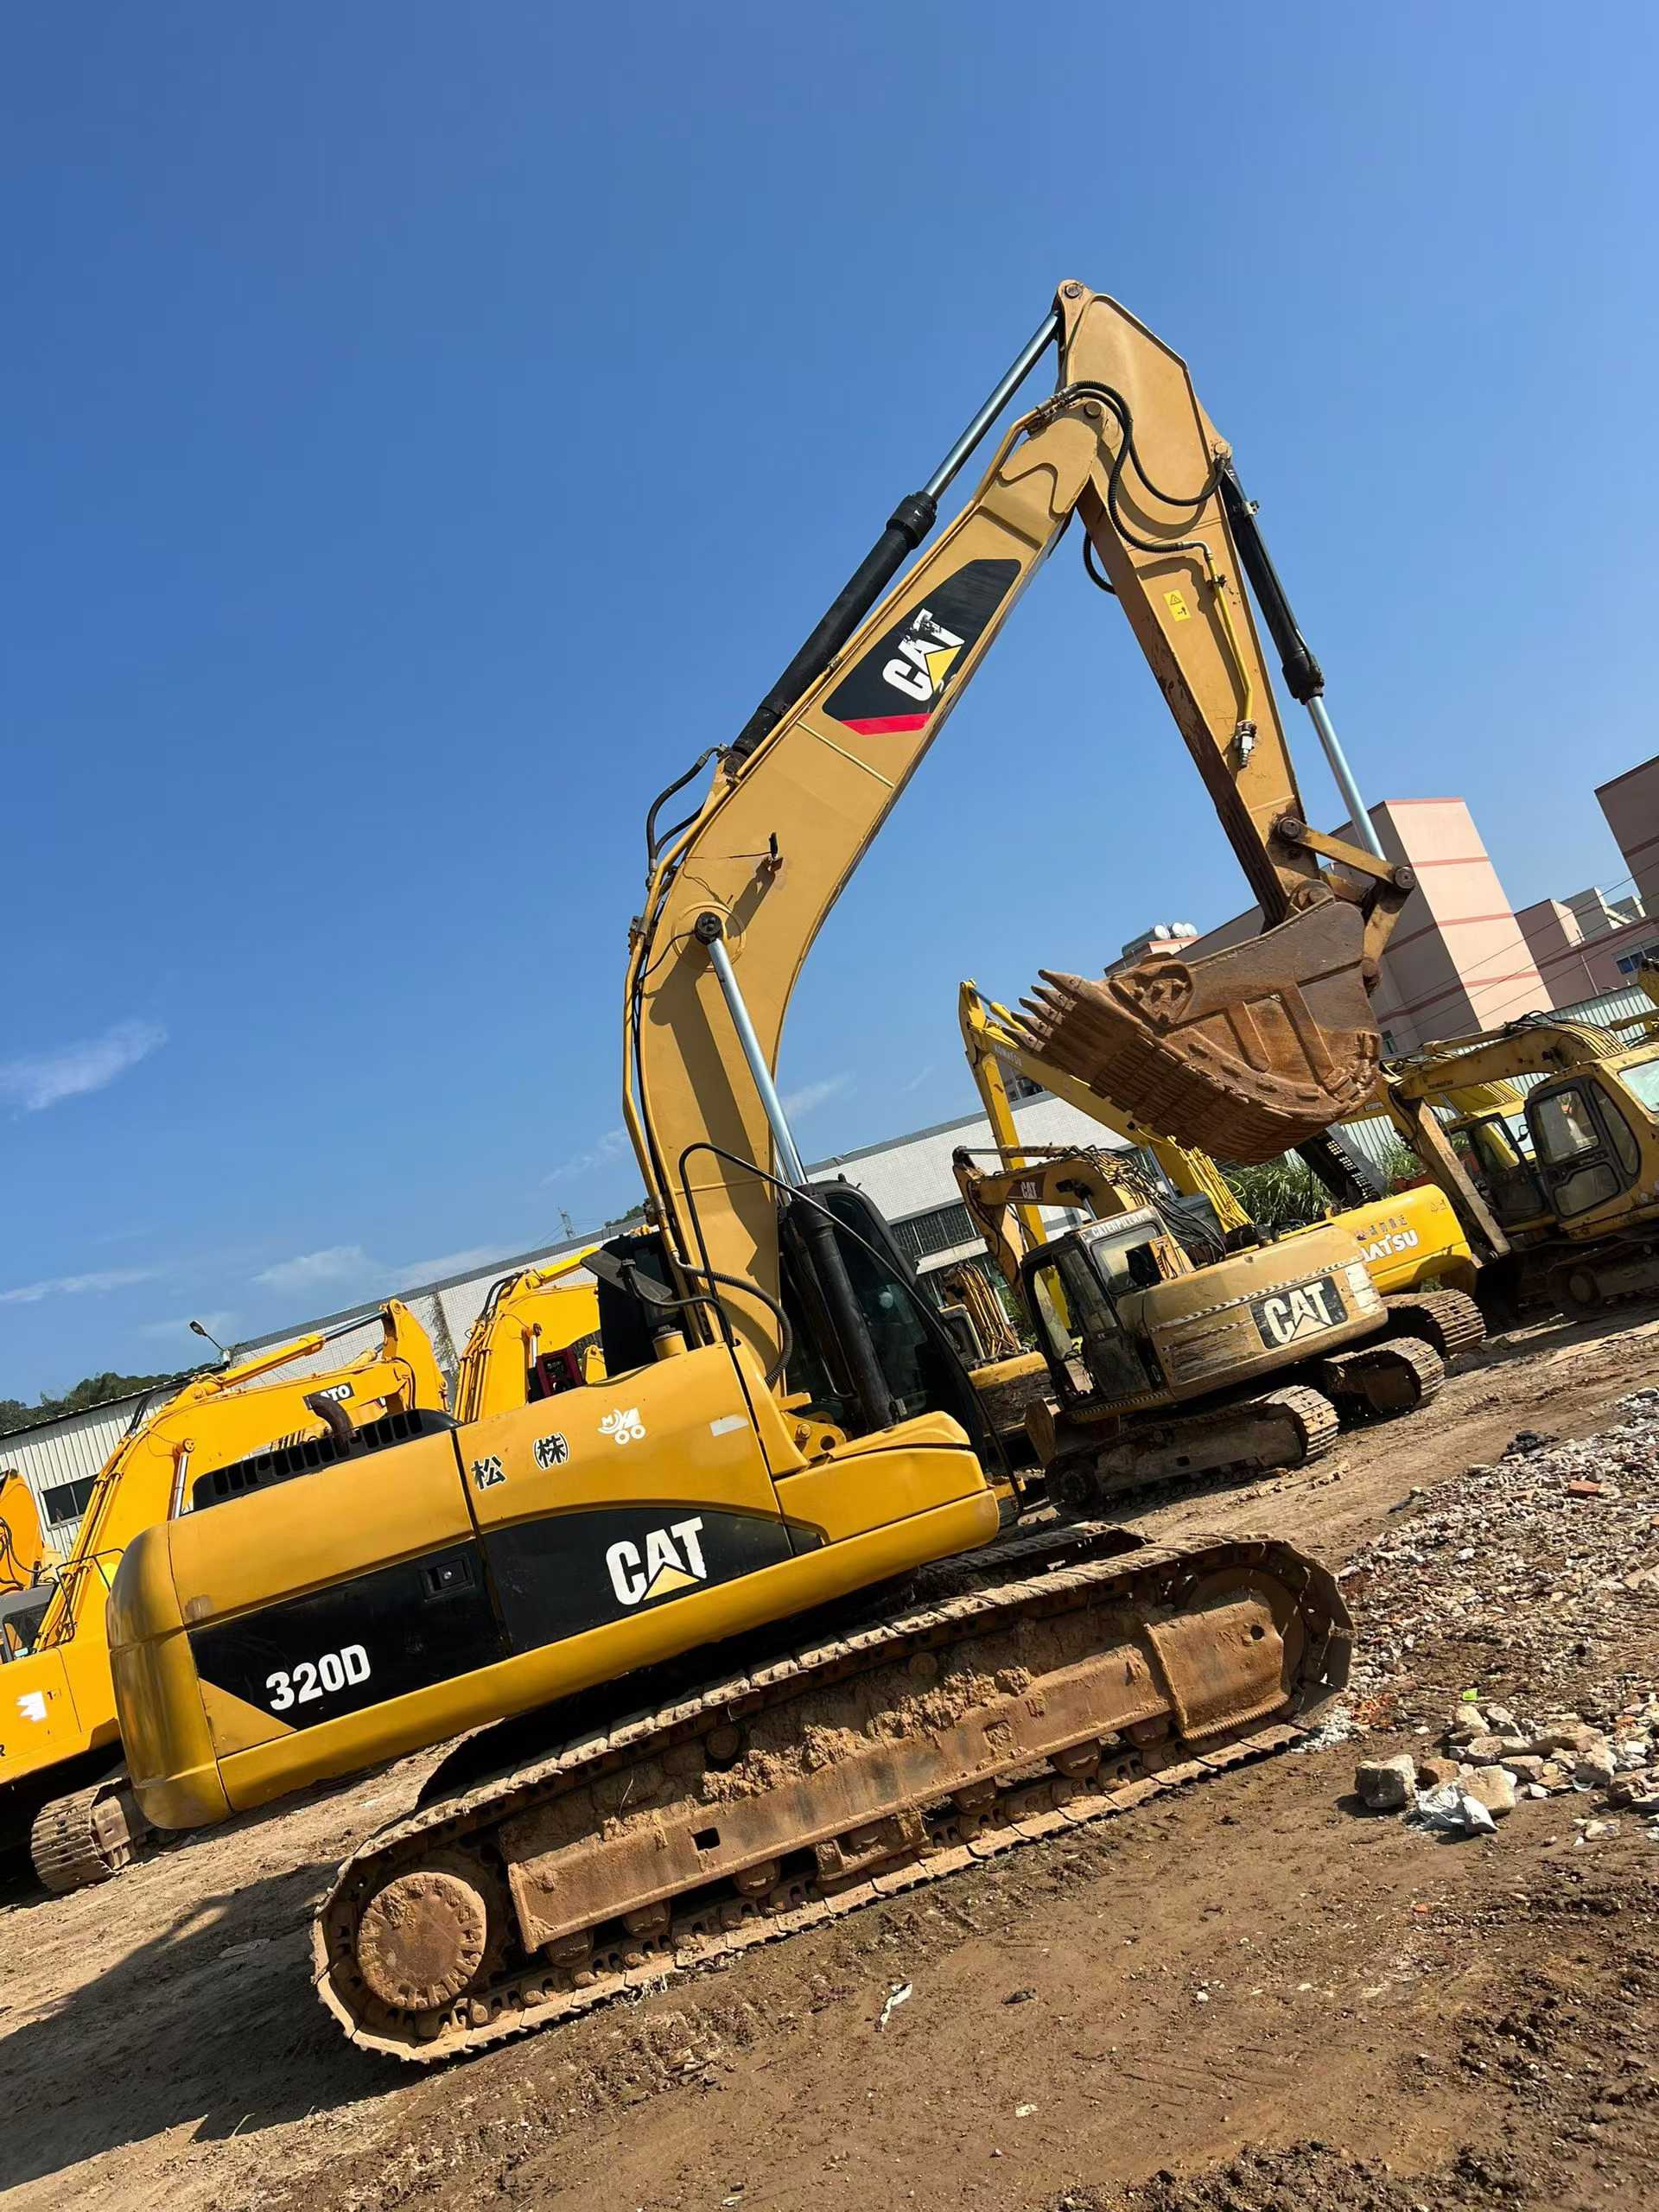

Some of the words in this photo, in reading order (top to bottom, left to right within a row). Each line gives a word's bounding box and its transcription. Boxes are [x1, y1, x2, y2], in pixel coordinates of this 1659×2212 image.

[882, 607, 965, 701] CAT
[1020, 1181, 1038, 1199] CAT
[1263, 1281, 1333, 1344] CAT
[470, 1455, 506, 1491] 松
[606, 1516, 708, 1605] CAT
[265, 1644, 372, 1711] 320D
